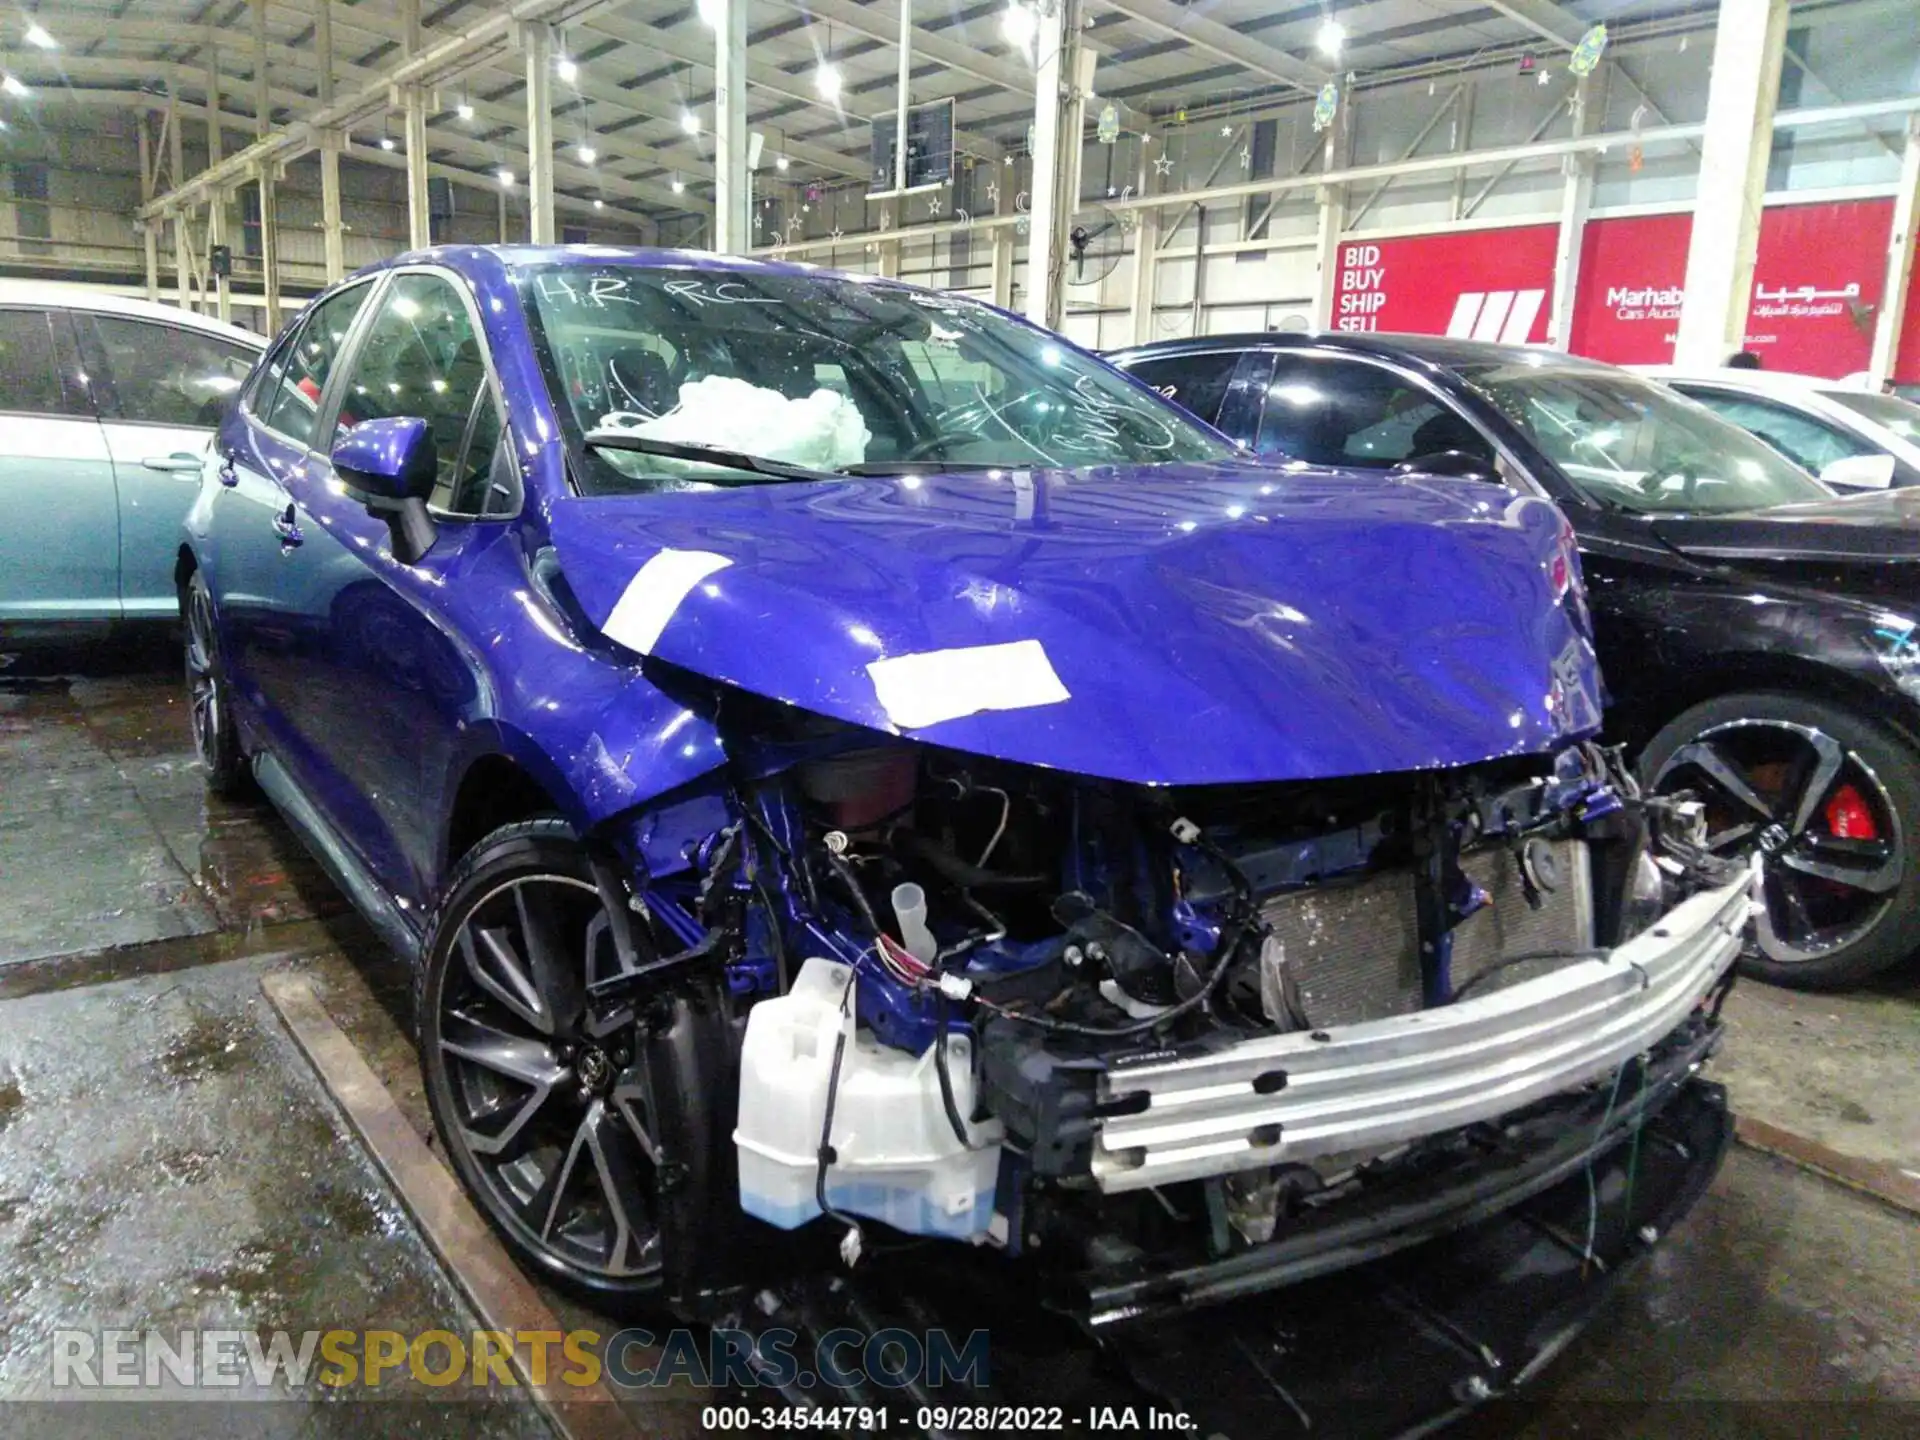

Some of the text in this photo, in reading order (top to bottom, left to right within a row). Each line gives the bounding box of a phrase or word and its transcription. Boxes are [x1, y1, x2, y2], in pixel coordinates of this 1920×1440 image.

[1344, 246, 1380, 267] BID
[1342, 268, 1385, 291] BUY
[1339, 292, 1387, 314] SHIP
[1606, 286, 1685, 307] Marhab
[1615, 307, 1645, 320] Cars
